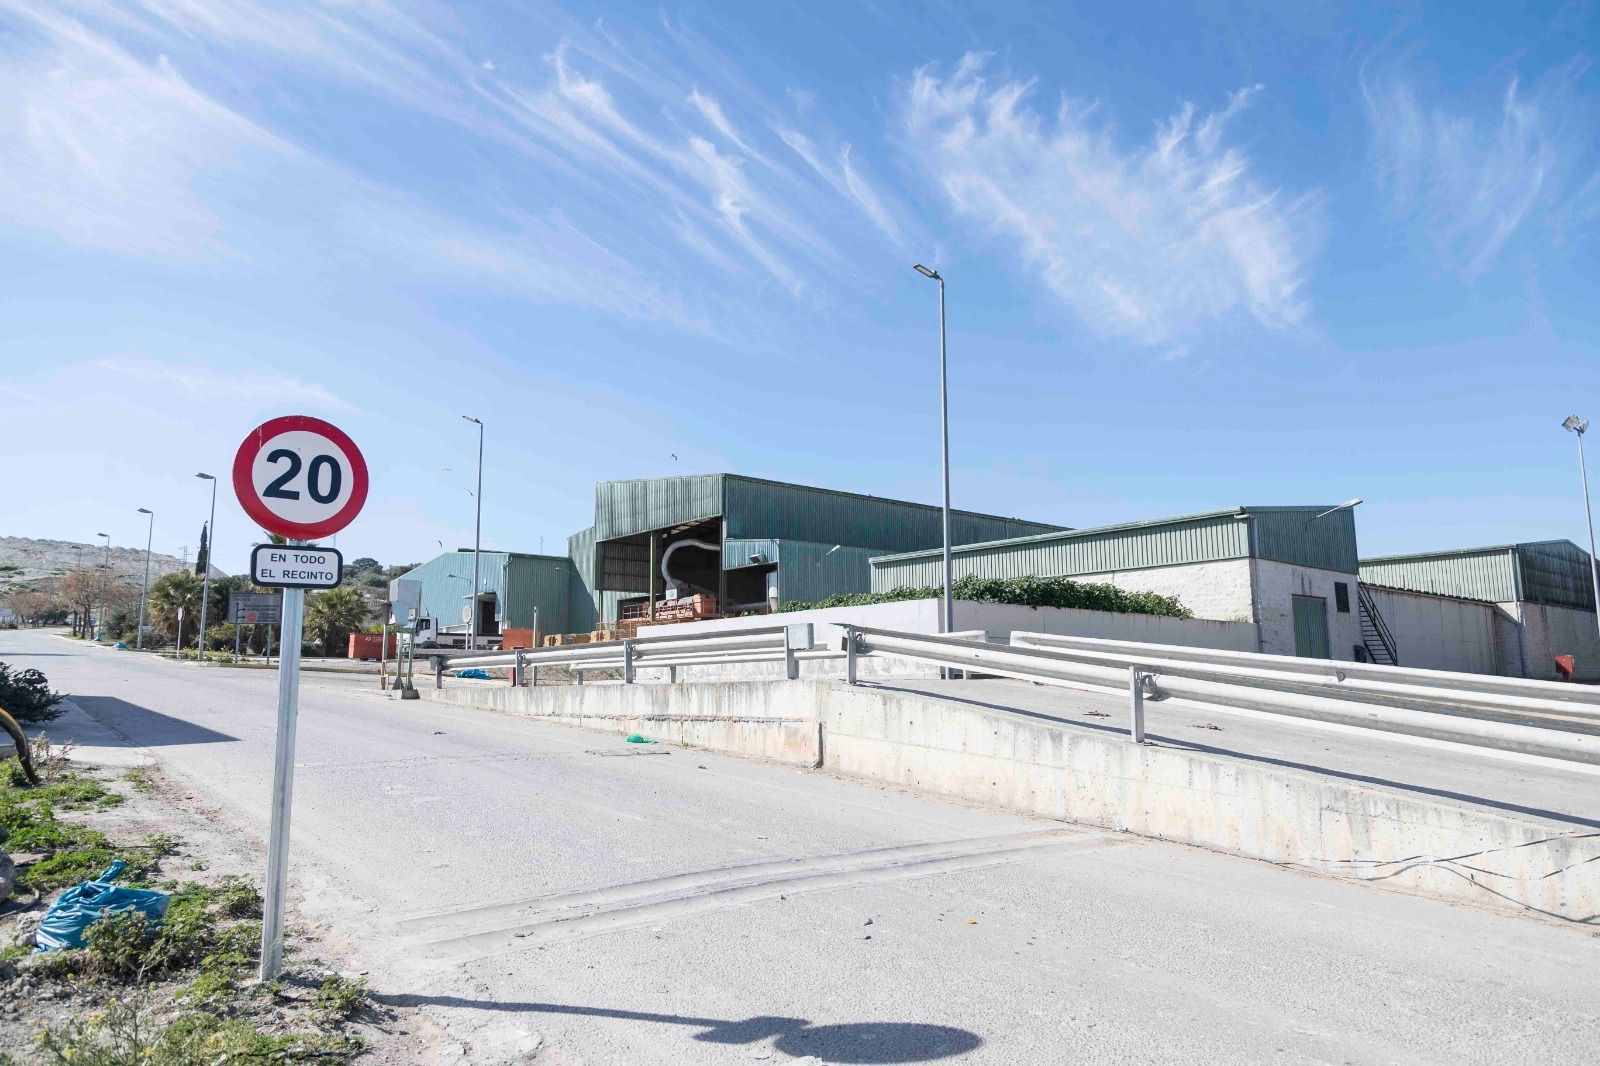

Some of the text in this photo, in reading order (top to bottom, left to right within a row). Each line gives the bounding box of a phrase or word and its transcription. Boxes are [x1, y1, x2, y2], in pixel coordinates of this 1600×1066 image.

[262, 449, 342, 504] 20
[270, 553, 326, 564] EN TODO
[260, 568, 334, 581] EL RECINTO
